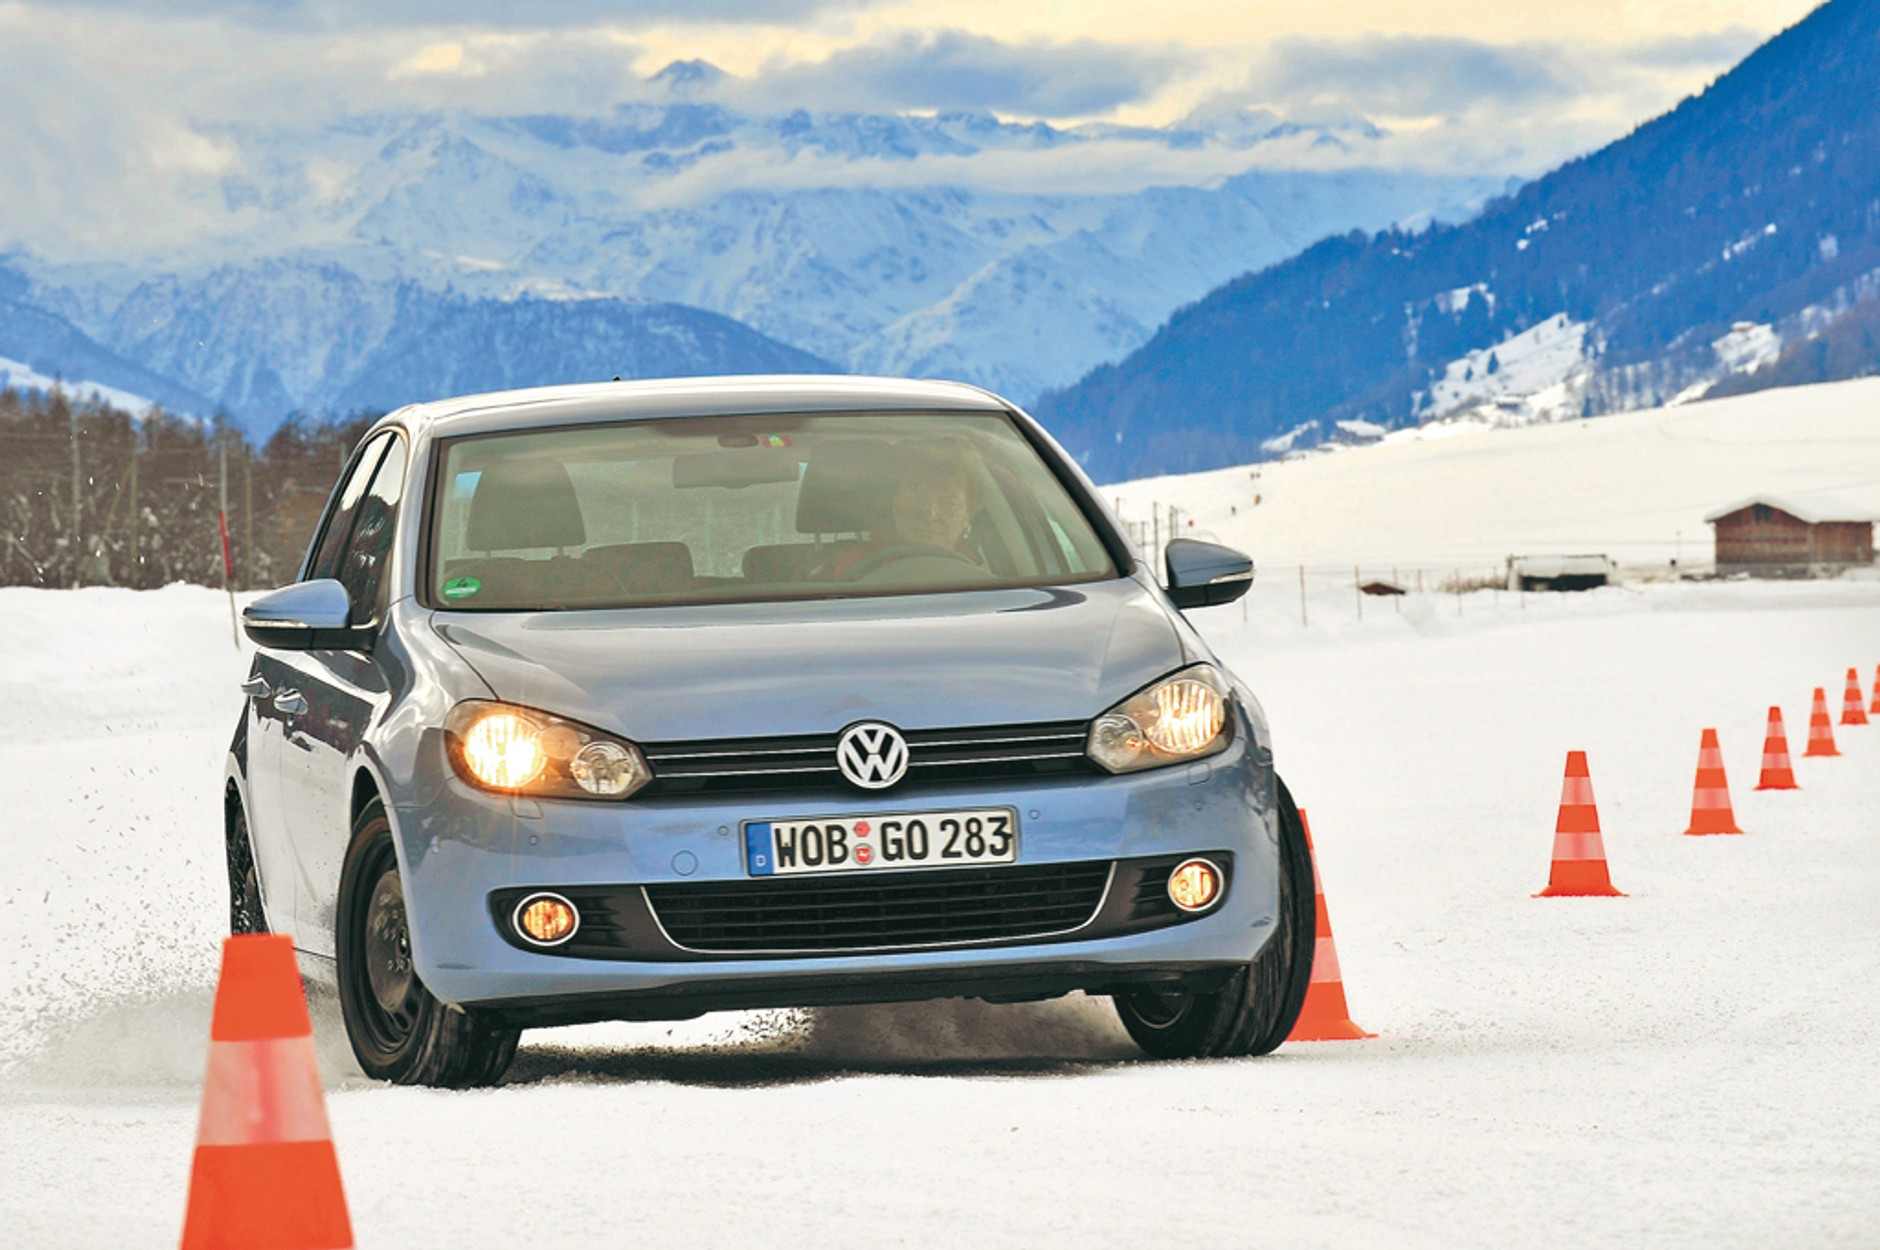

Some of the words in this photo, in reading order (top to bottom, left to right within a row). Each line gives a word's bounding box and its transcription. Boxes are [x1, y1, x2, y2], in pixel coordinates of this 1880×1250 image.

[840, 725, 907, 786] VW
[774, 824, 849, 867] WOB
[880, 818, 929, 861] GO
[939, 816, 1013, 858] 283
